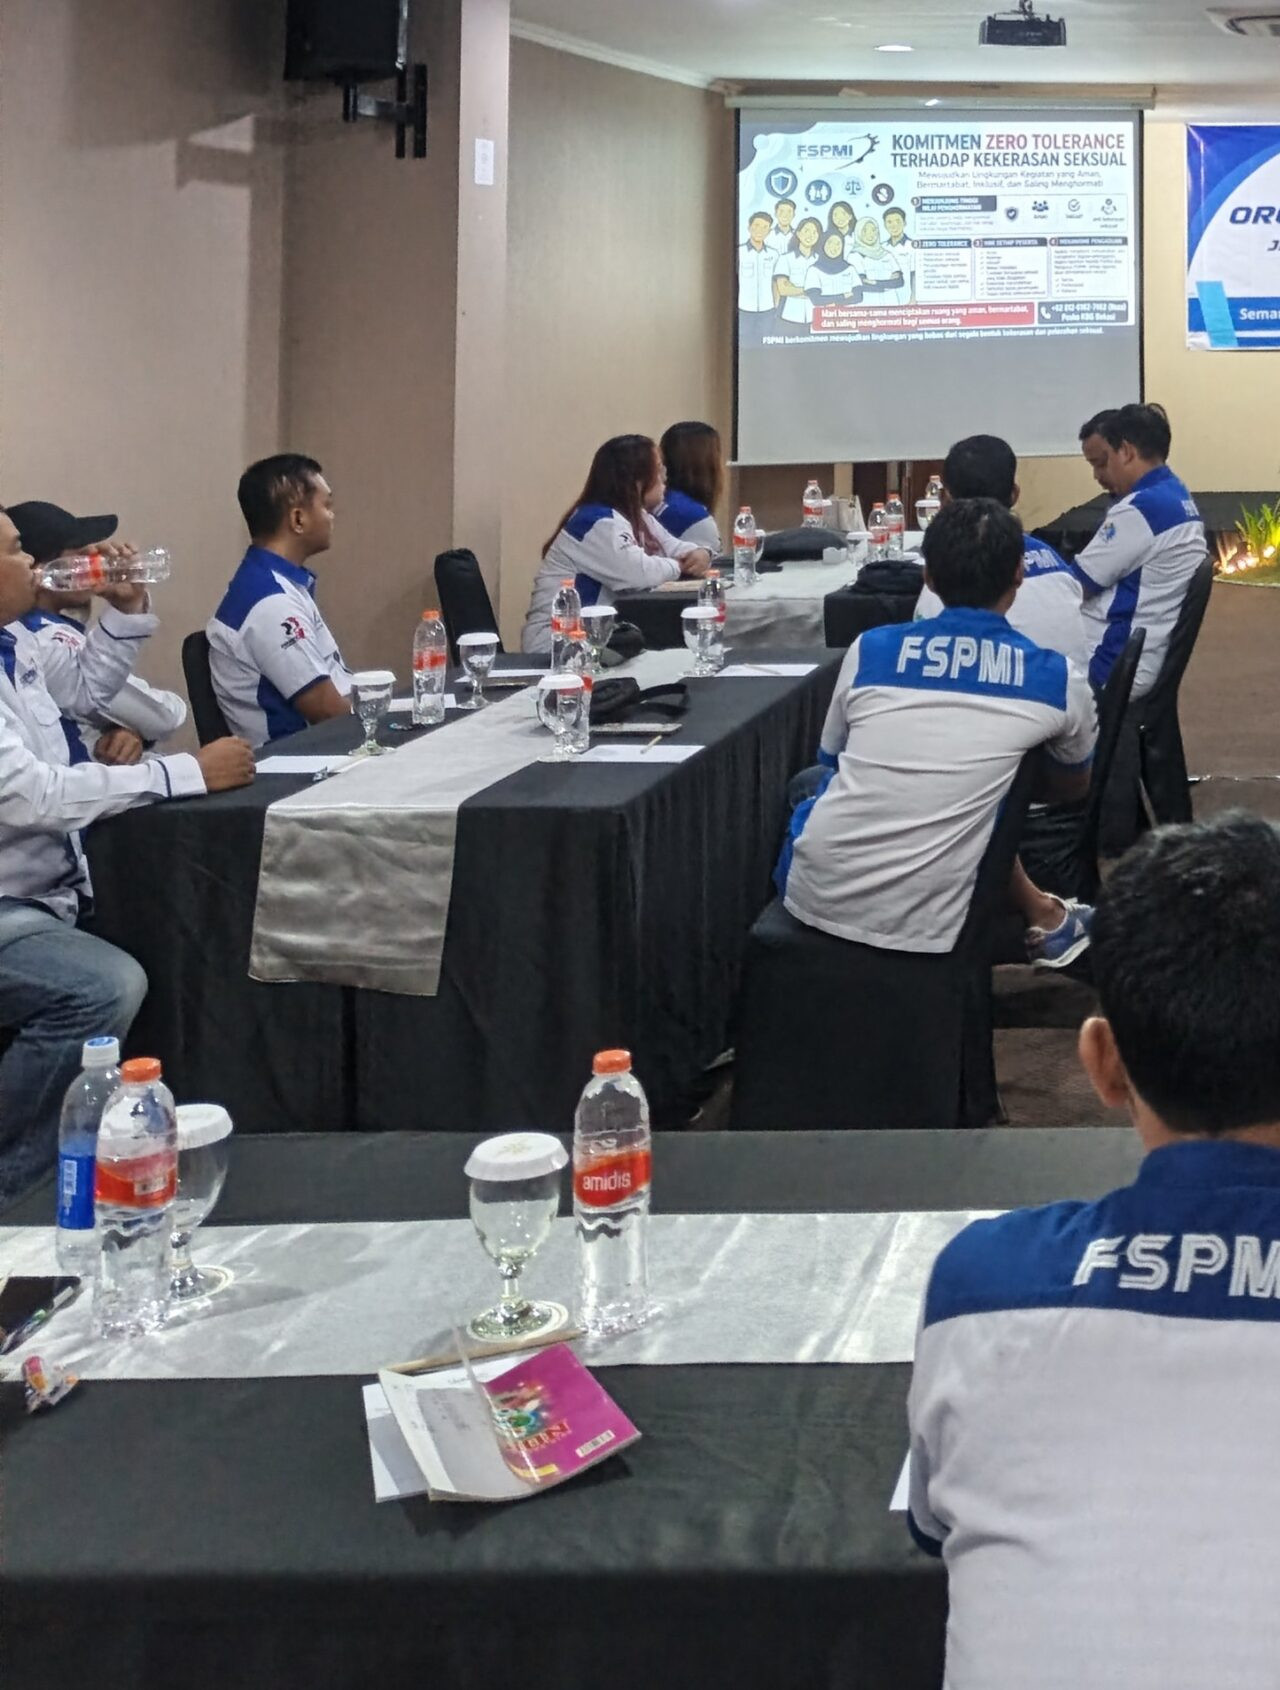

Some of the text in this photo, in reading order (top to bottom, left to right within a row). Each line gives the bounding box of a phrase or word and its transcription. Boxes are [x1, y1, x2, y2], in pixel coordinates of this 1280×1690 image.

[892, 133, 1125, 150] KOMITMEN ZERO TOLERANCE
[797, 144, 853, 157] FSPMI
[891, 152, 1127, 168] TERHADAP KEKERASAN SEKSUAL
[896, 636, 1024, 687] FSPMI
[582, 1169, 631, 1191] amidis
